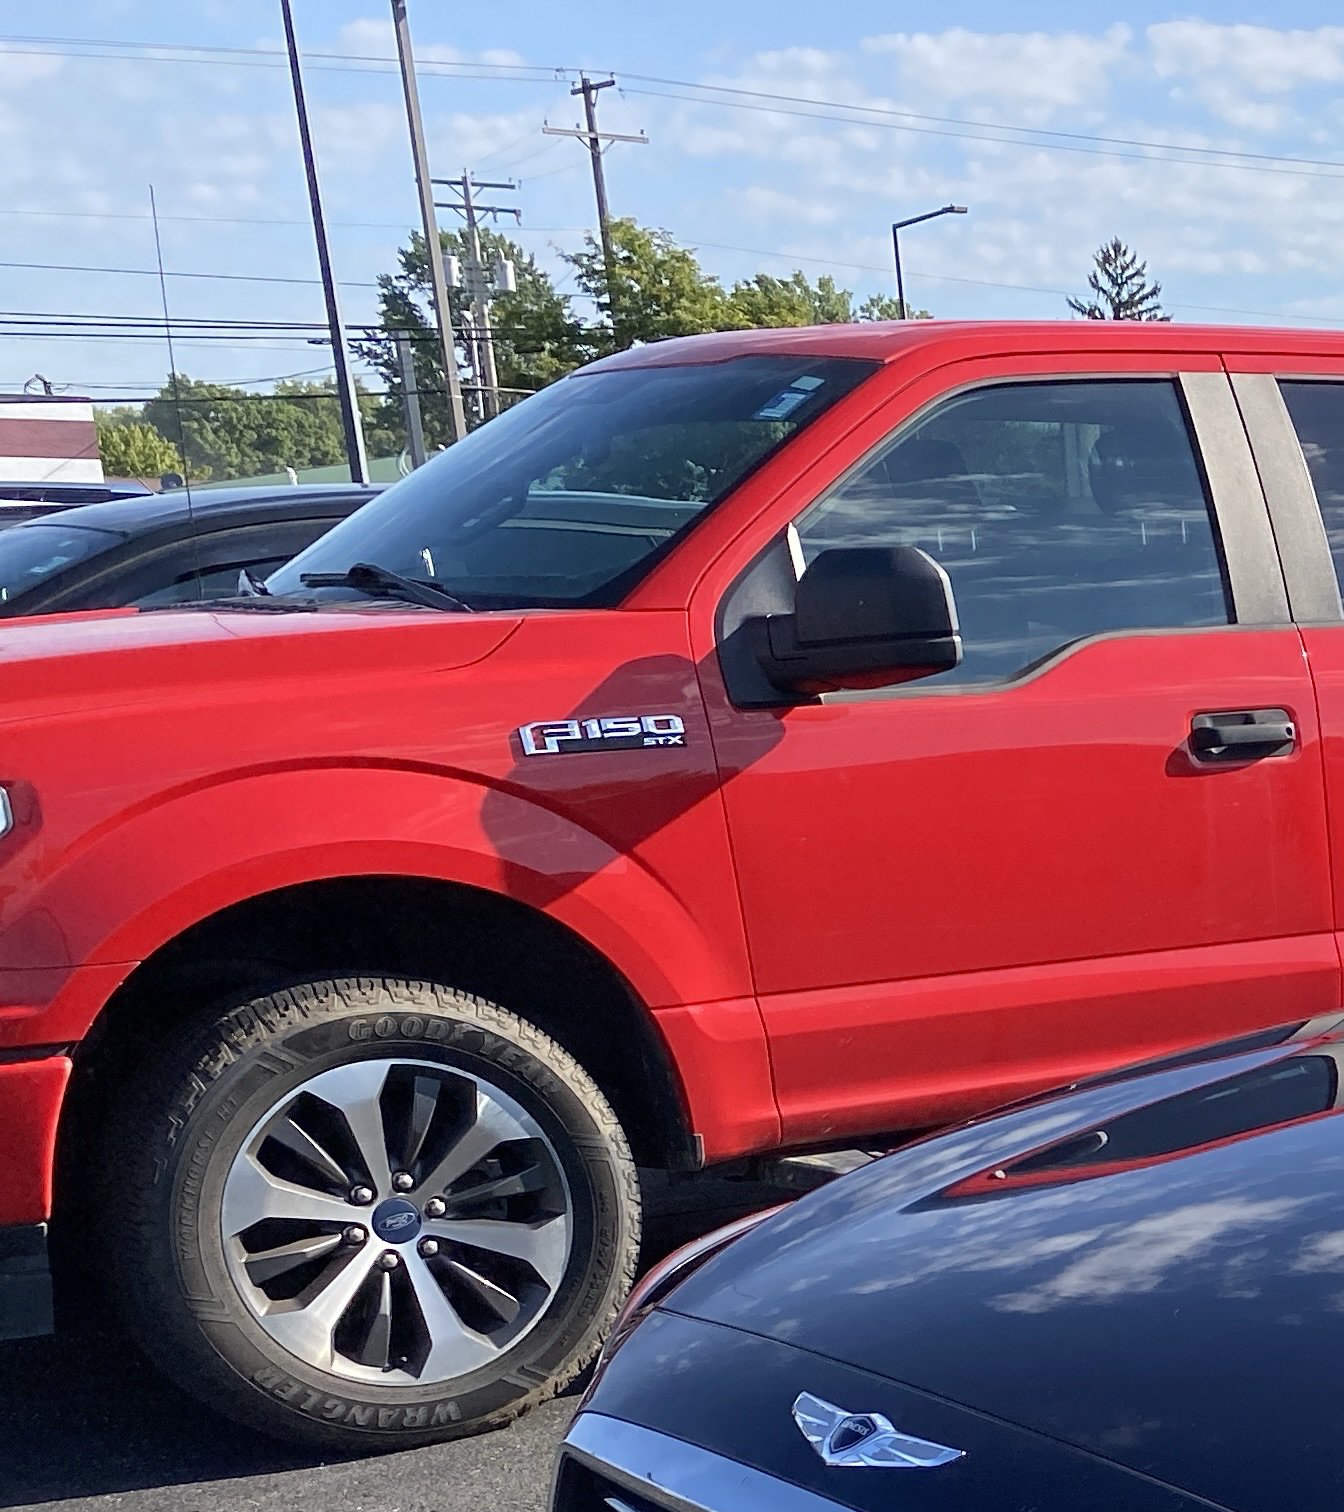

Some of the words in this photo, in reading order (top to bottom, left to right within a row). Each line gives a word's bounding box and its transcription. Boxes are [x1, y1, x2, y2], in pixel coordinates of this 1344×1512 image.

[643, 735, 684, 747] STX
[349, 1015, 562, 1098] GOODYEAR
[179, 1128, 218, 1261] WORKHORSE
[253, 1366, 463, 1428] WRANGLER
